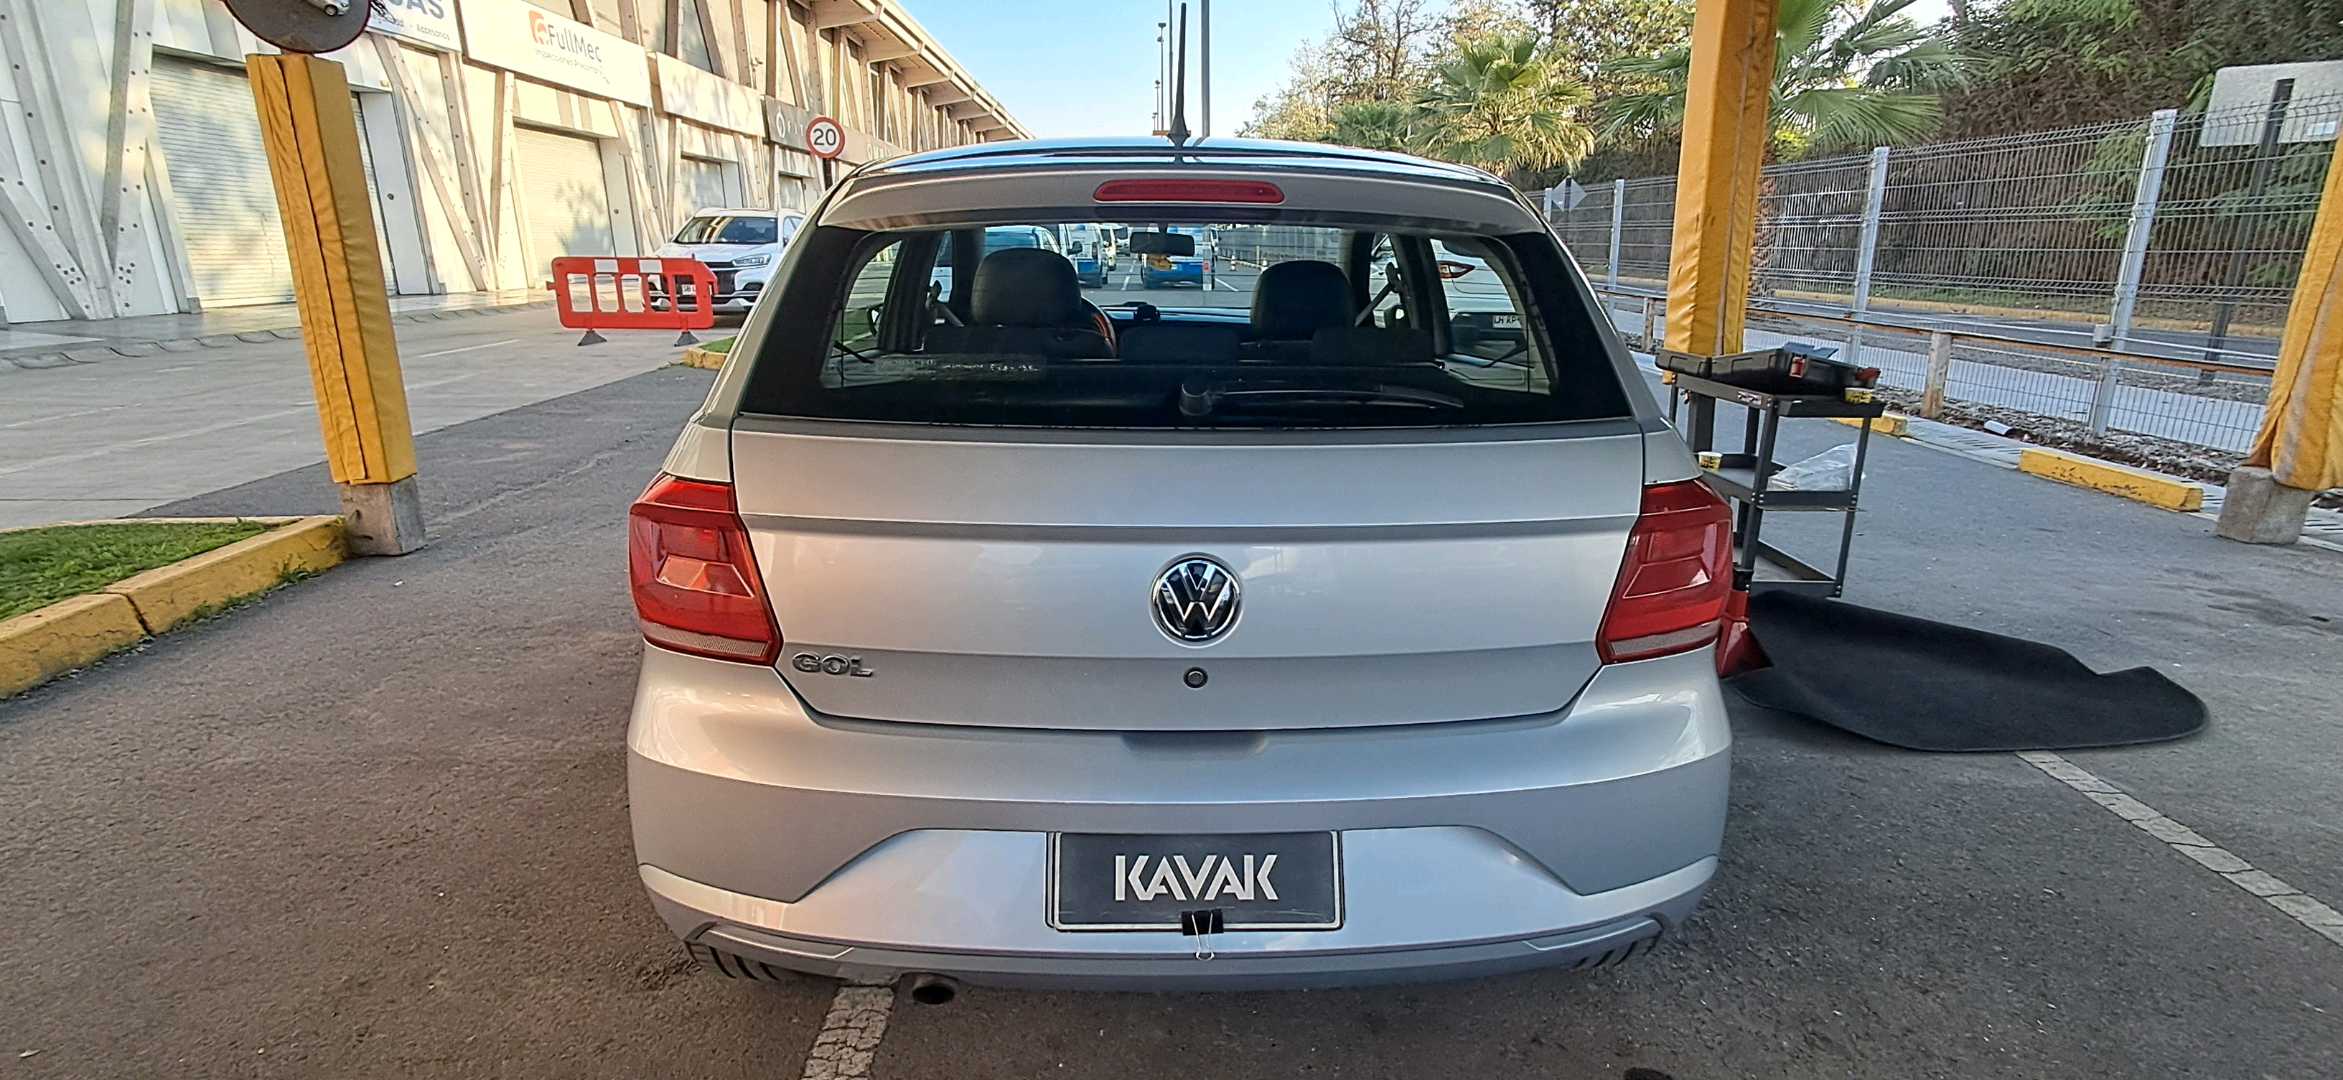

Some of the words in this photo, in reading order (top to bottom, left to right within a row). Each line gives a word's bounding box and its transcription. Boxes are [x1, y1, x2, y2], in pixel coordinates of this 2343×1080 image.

[547, 23, 603, 63] FullMec
[812, 127, 837, 146] 20
[792, 652, 874, 678] GOL
[1115, 854, 1280, 901] KAVAK
